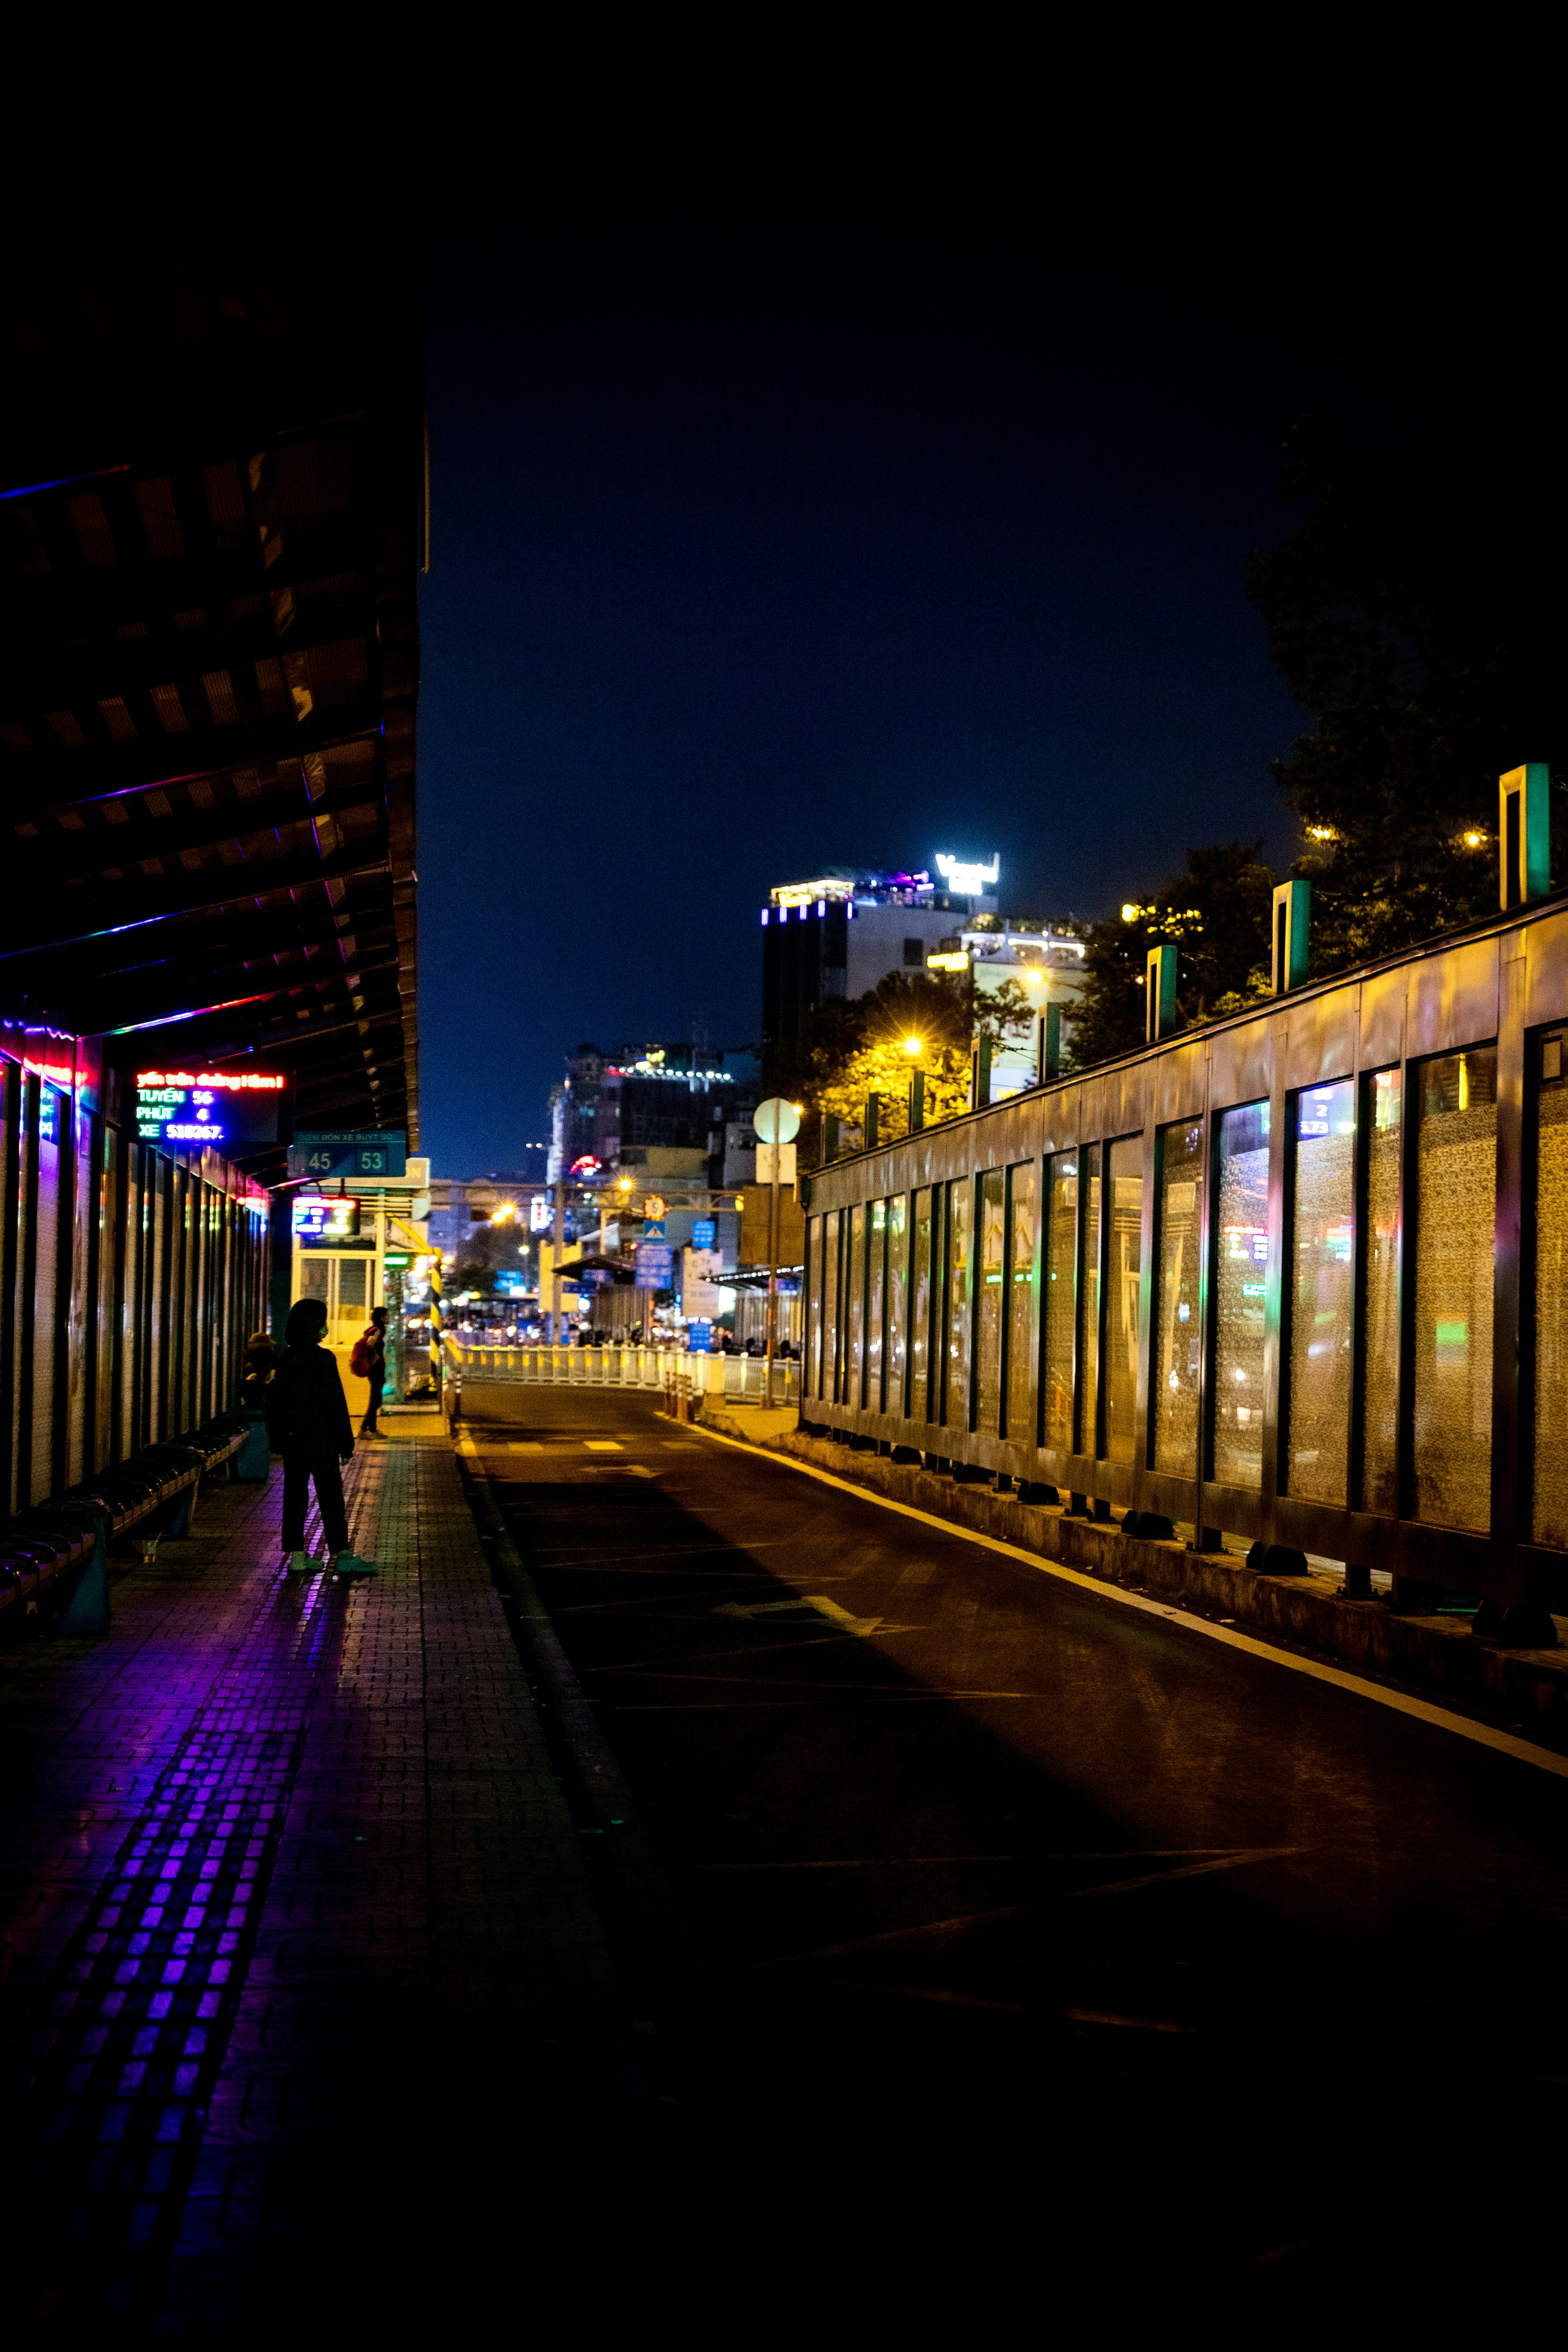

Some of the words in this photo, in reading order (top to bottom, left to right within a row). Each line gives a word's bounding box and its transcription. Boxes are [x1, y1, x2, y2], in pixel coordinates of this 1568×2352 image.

[165, 1072, 196, 1086] trên
[241, 1074, 276, 1088] Hàm
[137, 1087, 184, 1103] TUYẾN
[192, 1090, 213, 1104] 56
[136, 1105, 175, 1120] PHÚT
[196, 1108, 208, 1121] 4
[1317, 1104, 1328, 1118] 2
[139, 1124, 159, 1137] XE
[309, 1152, 331, 1170] 45
[361, 1152, 382, 1170] 53
